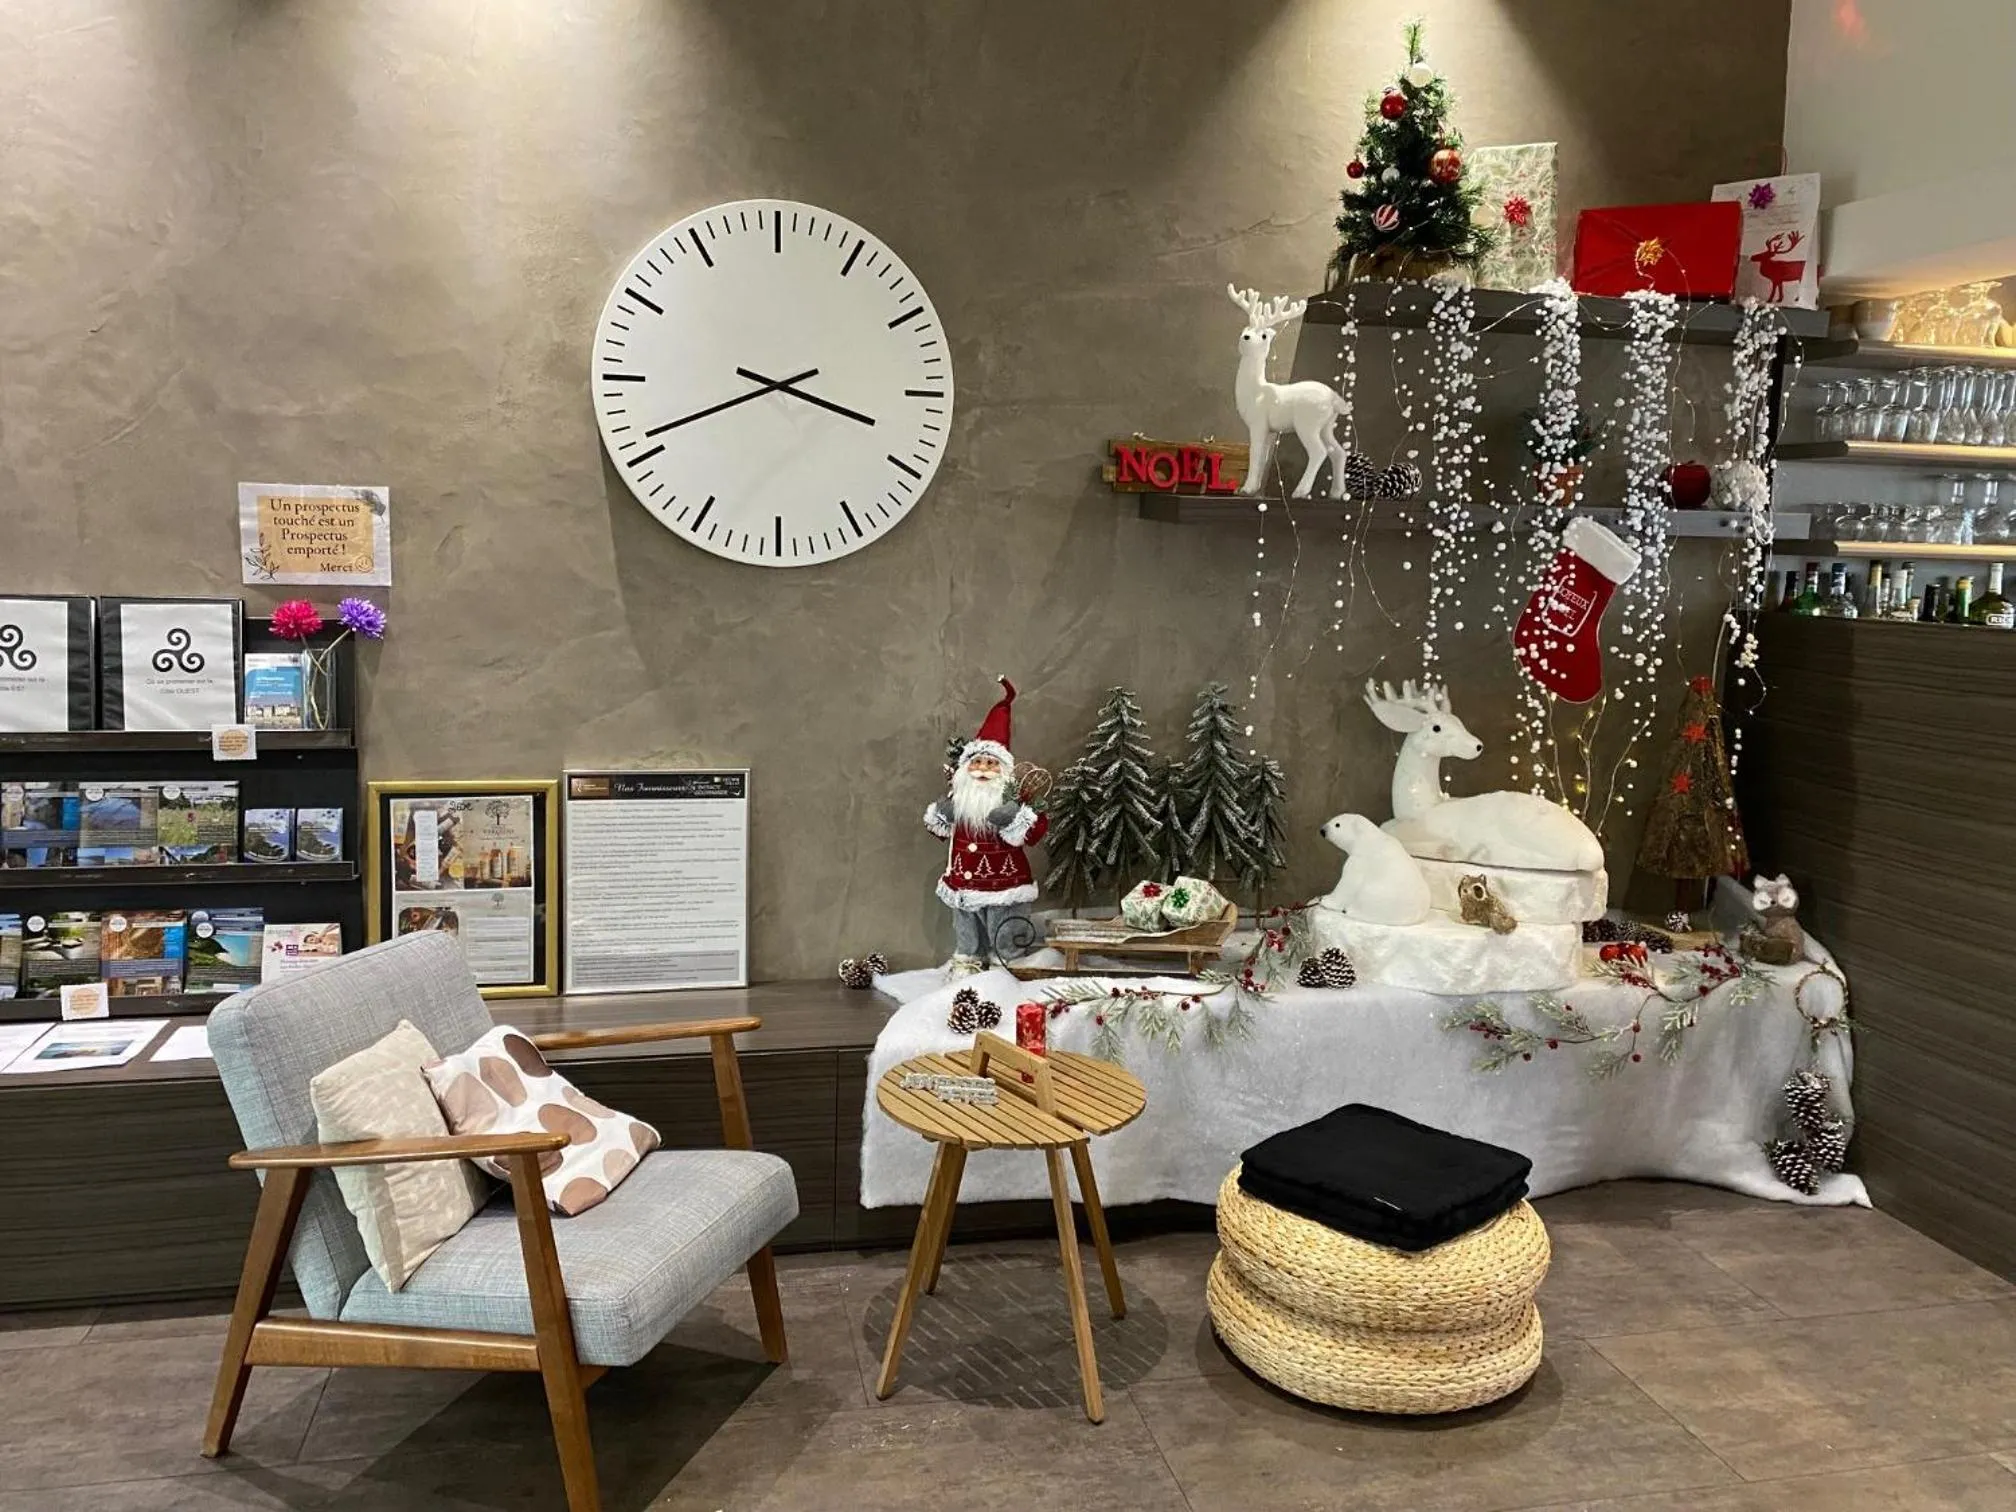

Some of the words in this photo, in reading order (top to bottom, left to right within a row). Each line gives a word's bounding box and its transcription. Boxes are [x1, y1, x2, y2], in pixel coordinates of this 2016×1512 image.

[1113, 443, 1239, 491] NOEL
[270, 498, 292, 512] Un
[294, 502, 360, 515] prospectus
[273, 514, 316, 528] touché
[318, 518, 336, 528] est
[339, 519, 355, 528] un
[282, 528, 348, 544] Prospectus
[287, 546, 340, 558] emporté
[320, 562, 353, 573] Merci
